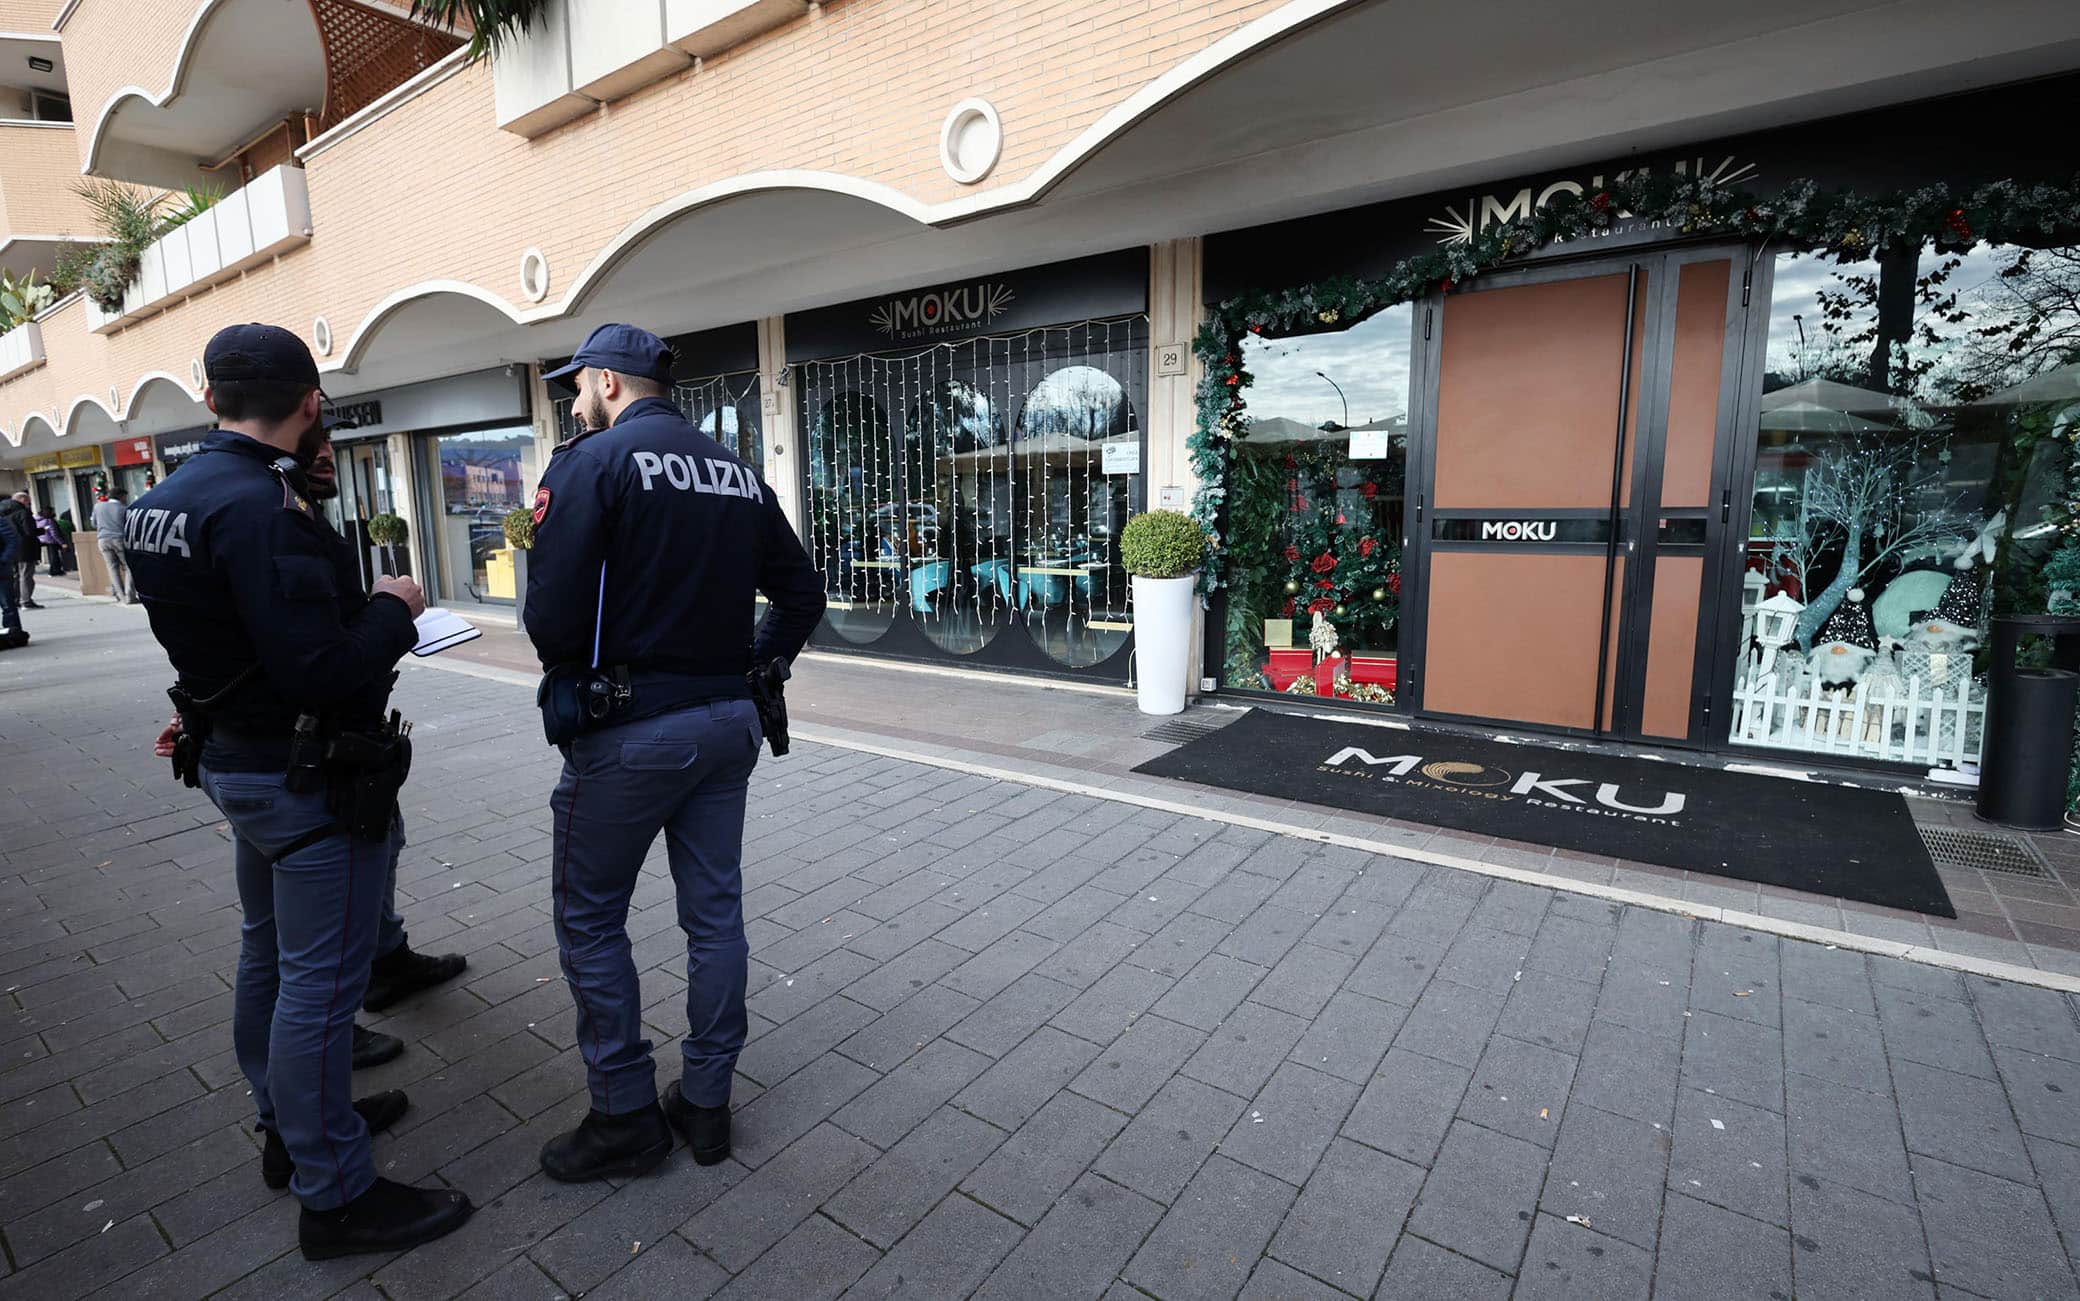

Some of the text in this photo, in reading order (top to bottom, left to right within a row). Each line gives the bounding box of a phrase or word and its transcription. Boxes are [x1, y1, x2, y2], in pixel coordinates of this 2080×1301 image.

[895, 285, 984, 330] MOKU
[901, 321, 981, 339] Sushi Restaurant
[1164, 353, 1177, 366] 29
[633, 451, 763, 504] POLIZIA
[124, 508, 191, 558] OLIZIA
[1482, 521, 1557, 541] MOKU
[1316, 765, 1374, 779] Sushi
[1406, 779, 1515, 801] Mixology
[1526, 797, 1681, 827] Restaurant
[1324, 746, 1686, 815] MOKU
